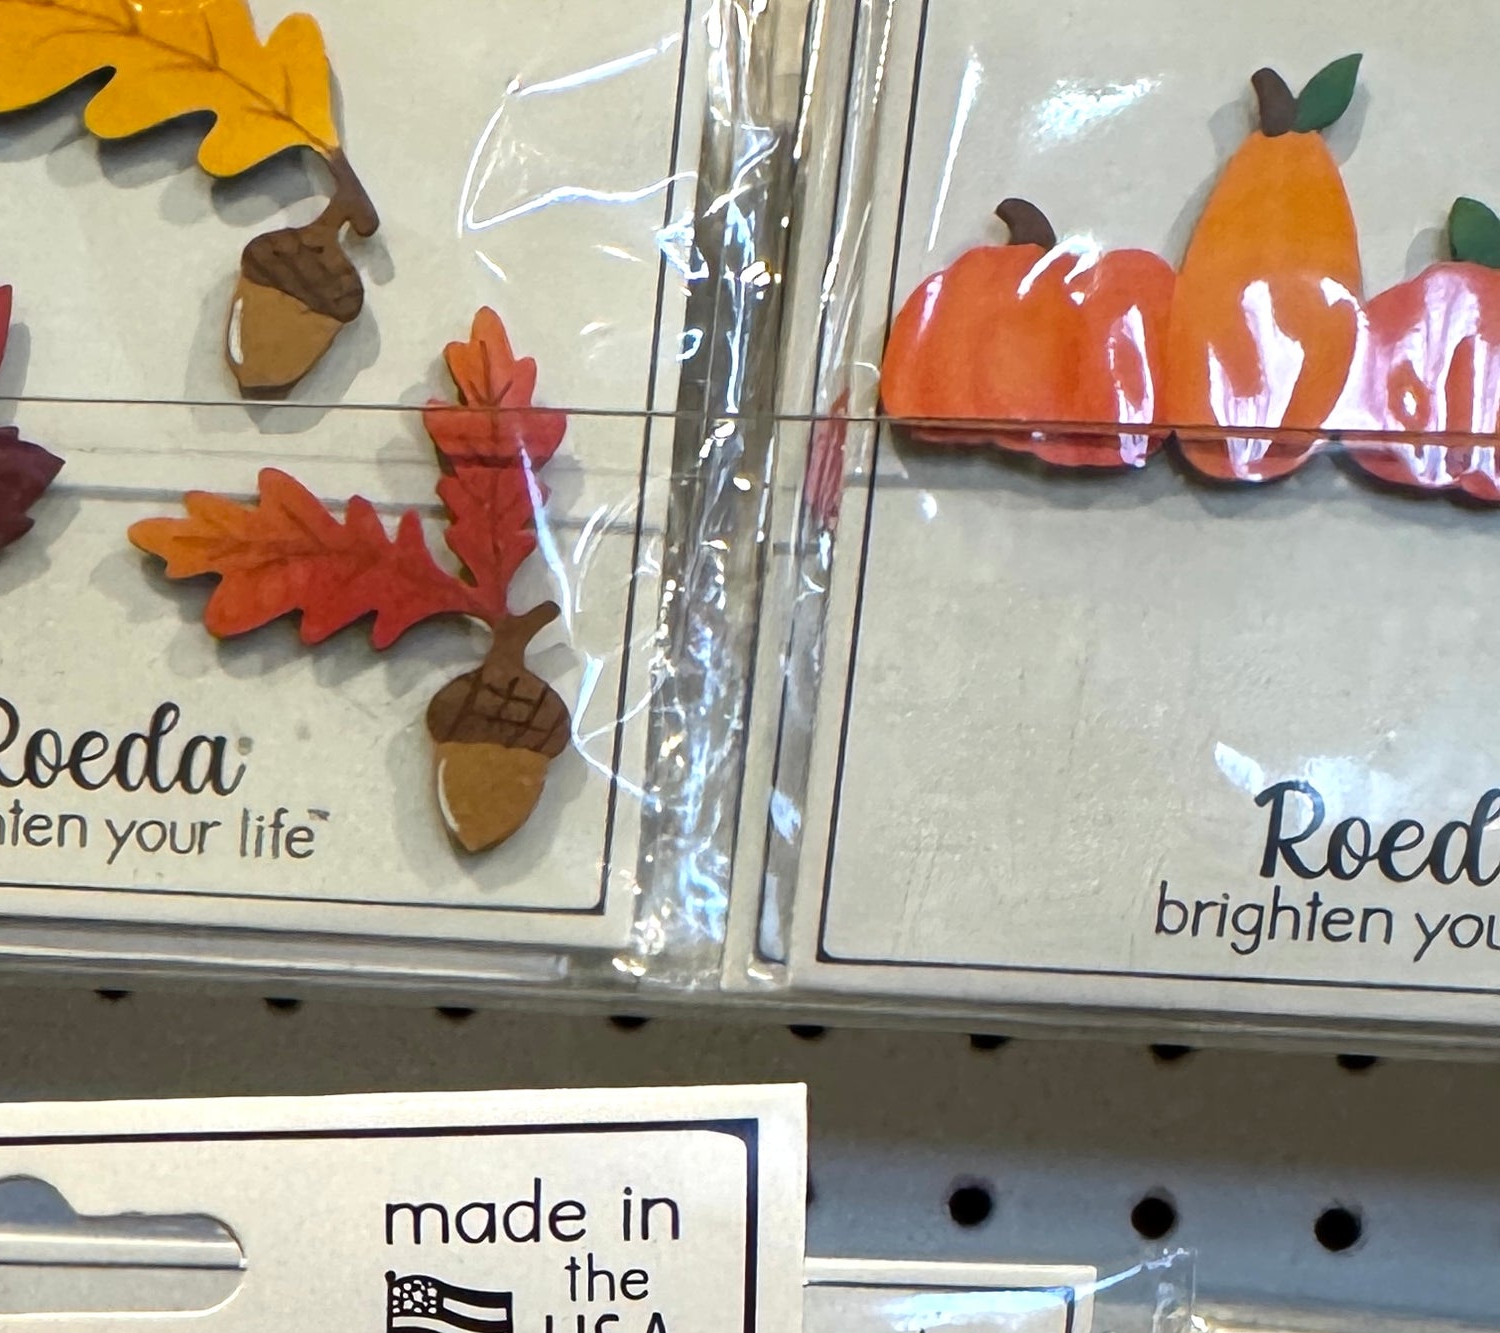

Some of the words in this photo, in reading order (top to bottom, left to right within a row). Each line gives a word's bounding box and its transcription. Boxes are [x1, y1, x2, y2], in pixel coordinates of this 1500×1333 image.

[105, 819, 222, 864] your
[1155, 880, 1393, 955] brighten
[386, 1178, 586, 1245] made
[623, 1187, 680, 1242] in
[565, 1253, 649, 1301] the
